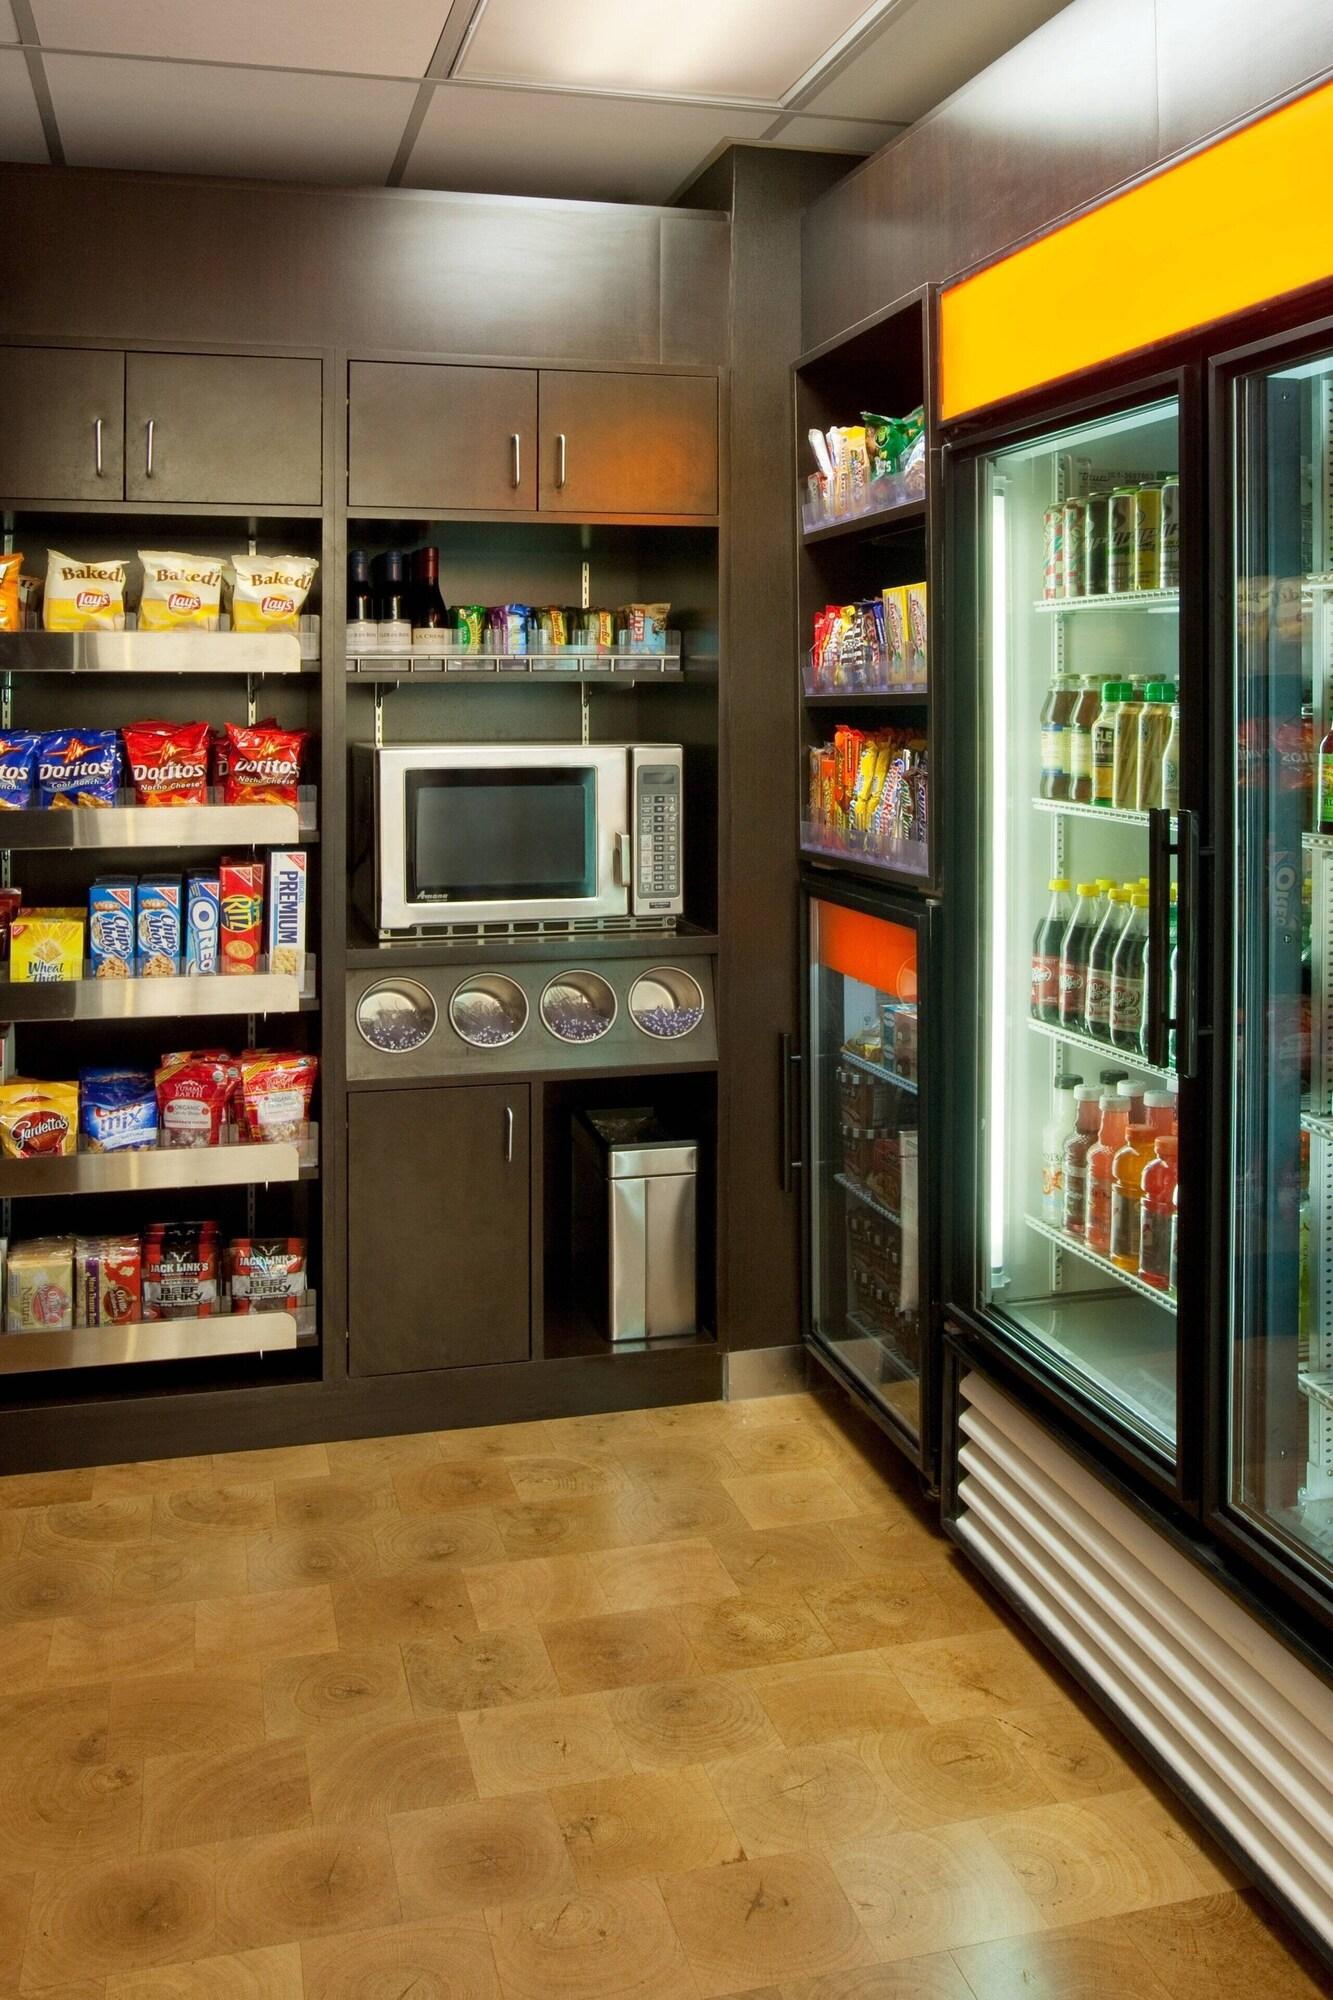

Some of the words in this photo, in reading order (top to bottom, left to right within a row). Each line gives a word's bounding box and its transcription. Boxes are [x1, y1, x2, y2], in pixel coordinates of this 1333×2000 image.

[61, 565, 123, 582] Baked!
[157, 569, 220, 587] Baked!
[251, 572, 312, 590] Baked!
[635, 608, 643, 637] CLIF
[39, 761, 111, 780] Doritos
[133, 761, 205, 781] Doritos
[234, 757, 299, 775] Doritos
[140, 783, 167, 791] Nacho
[223, 896, 253, 930] RITZ
[279, 871, 298, 944] PREMIUM
[101, 916, 127, 958] Ahoy!
[115, 916, 132, 952] Chips
[148, 915, 174, 957] Ahoy!
[162, 915, 178, 952] Chips
[192, 901, 216, 971] OREO
[28, 960, 65, 975] Wheat
[100, 1107, 144, 1132] mix
[10, 1117, 70, 1150] Gardetto's
[151, 1263, 174, 1273] JACK
[177, 1262, 209, 1273] LINK'S
[161, 1286, 199, 1295] BEEF
[245, 1284, 292, 1295] JERKY
[250, 1279, 287, 1288] BEEF
[157, 1291, 204, 1301] JERKY
[22, 1287, 34, 1326] Natural
